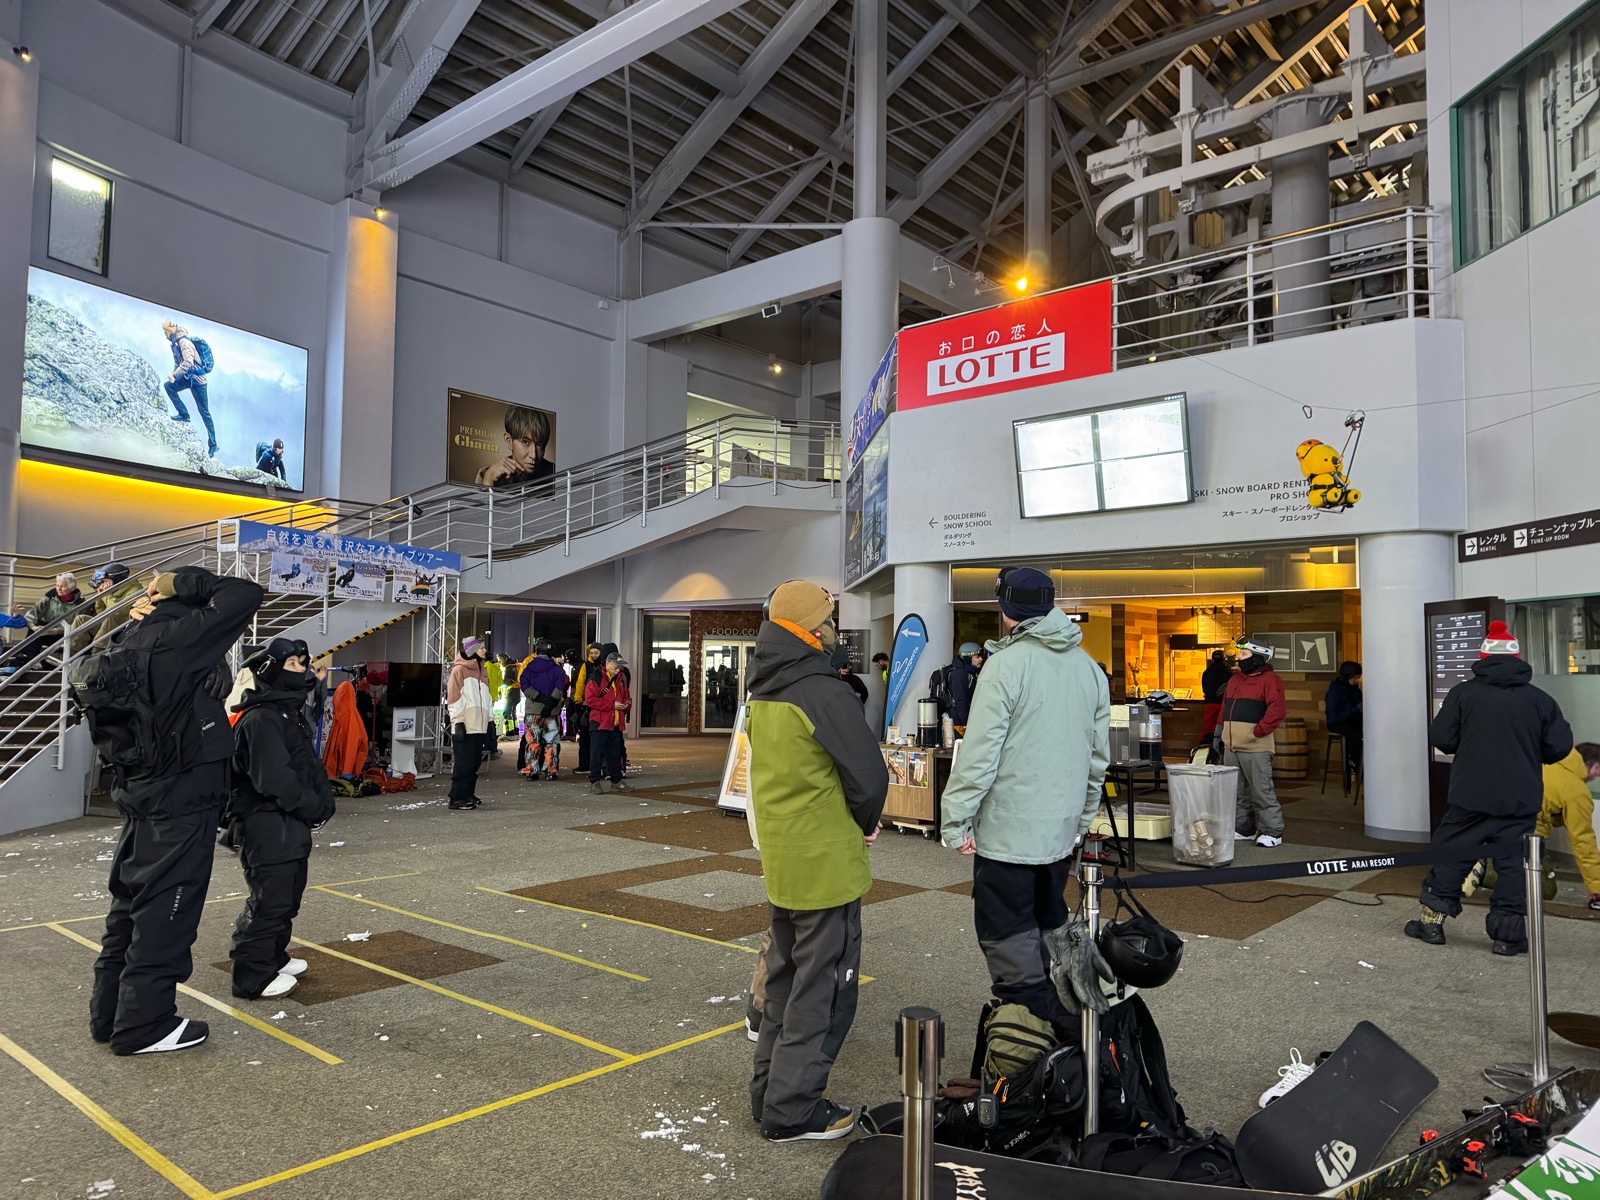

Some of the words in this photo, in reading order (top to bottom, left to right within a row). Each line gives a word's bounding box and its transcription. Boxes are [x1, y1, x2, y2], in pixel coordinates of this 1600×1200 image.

[939, 318, 1052, 355] お口の恋人
[939, 342, 1051, 387] LOTTE
[460, 425, 498, 440] PREMIUM
[454, 434, 500, 453] Ghana
[1194, 489, 1208, 498] SKI
[1216, 485, 1245, 496] SNOW
[1247, 481, 1280, 492] BOARD
[1270, 492, 1290, 501] PRO
[943, 511, 987, 521] BOULDERING
[1279, 512, 1321, 523] プロショップ
[943, 522, 964, 530] SNOW
[965, 519, 992, 528] SCHOOL
[1479, 532, 1508, 546] レンタル
[1530, 536, 1553, 545] TUNE-UP
[1554, 533, 1570, 541] ROOM
[1480, 545, 1497, 553] RENTAL
[712, 627, 739, 636] FOOD
[1306, 860, 1349, 874] LOTTE
[1351, 860, 1369, 869] ARAI
[1369, 857, 1395, 868] RESORT
